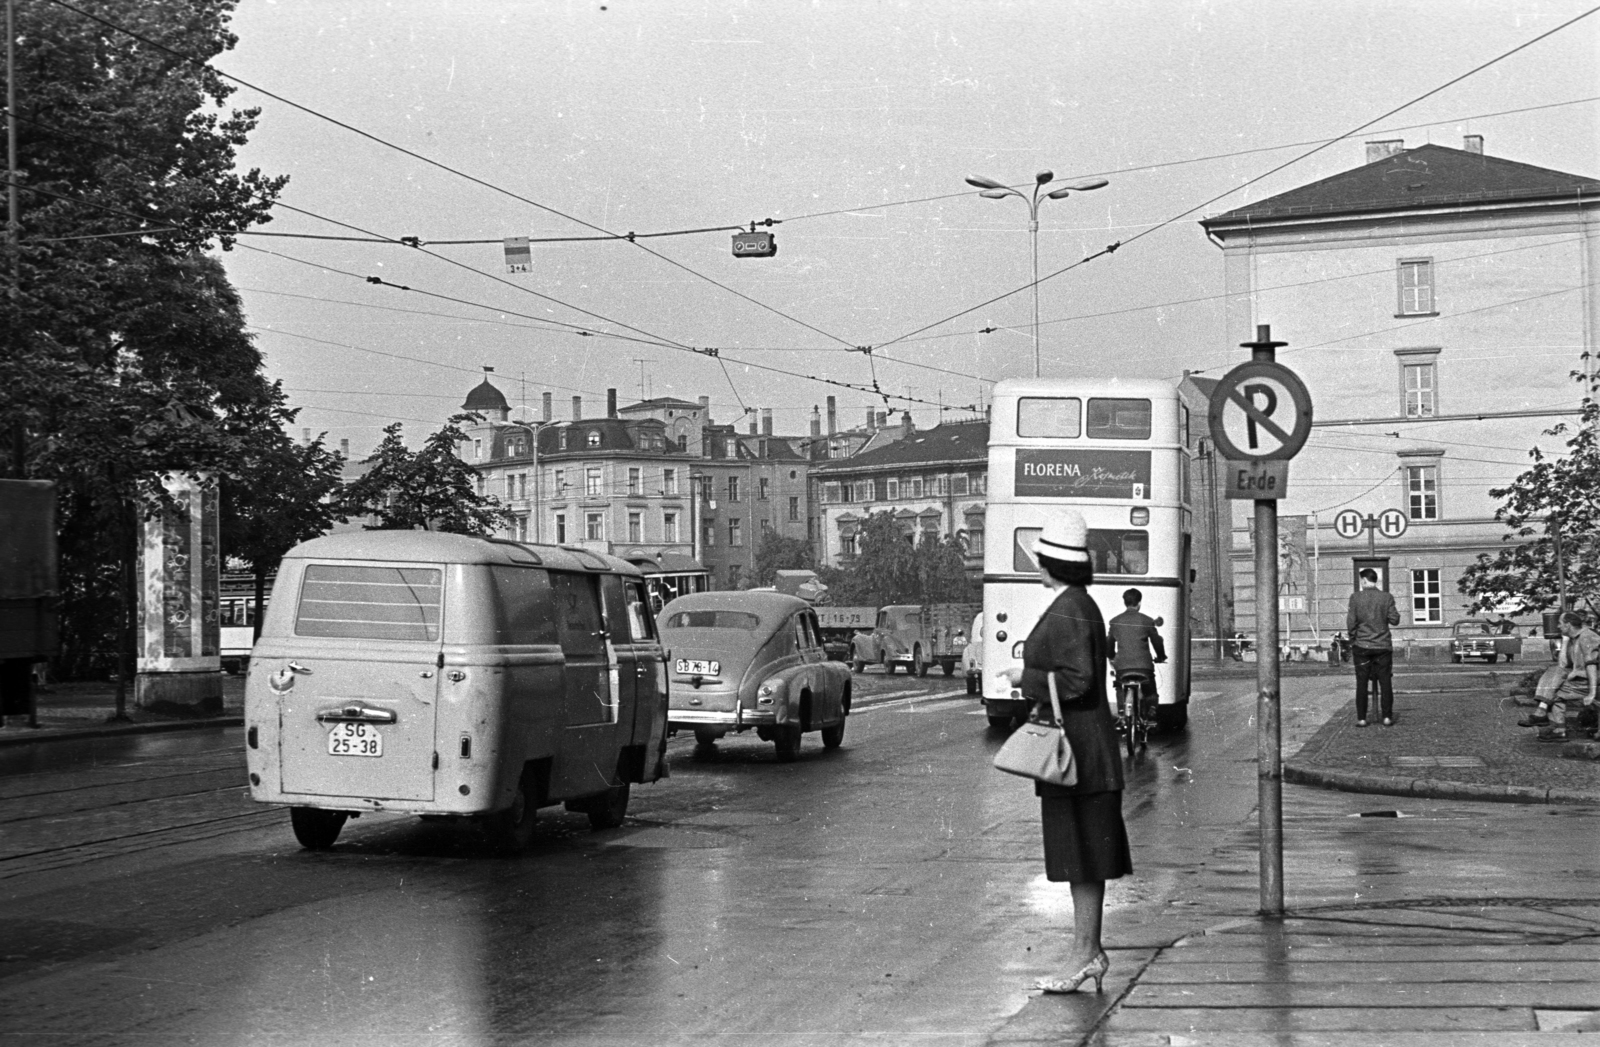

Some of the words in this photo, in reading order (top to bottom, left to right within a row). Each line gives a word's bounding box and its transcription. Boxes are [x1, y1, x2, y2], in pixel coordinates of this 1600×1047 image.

[1244, 383, 1277, 449] P
[1024, 462, 1081, 477] FLORENA
[1237, 469, 1276, 490] Ende
[1342, 515, 1357, 533] H
[1385, 514, 1400, 532] H
[677, 660, 690, 672] SB
[345, 722, 366, 737] SG
[333, 738, 378, 754] 25-38
